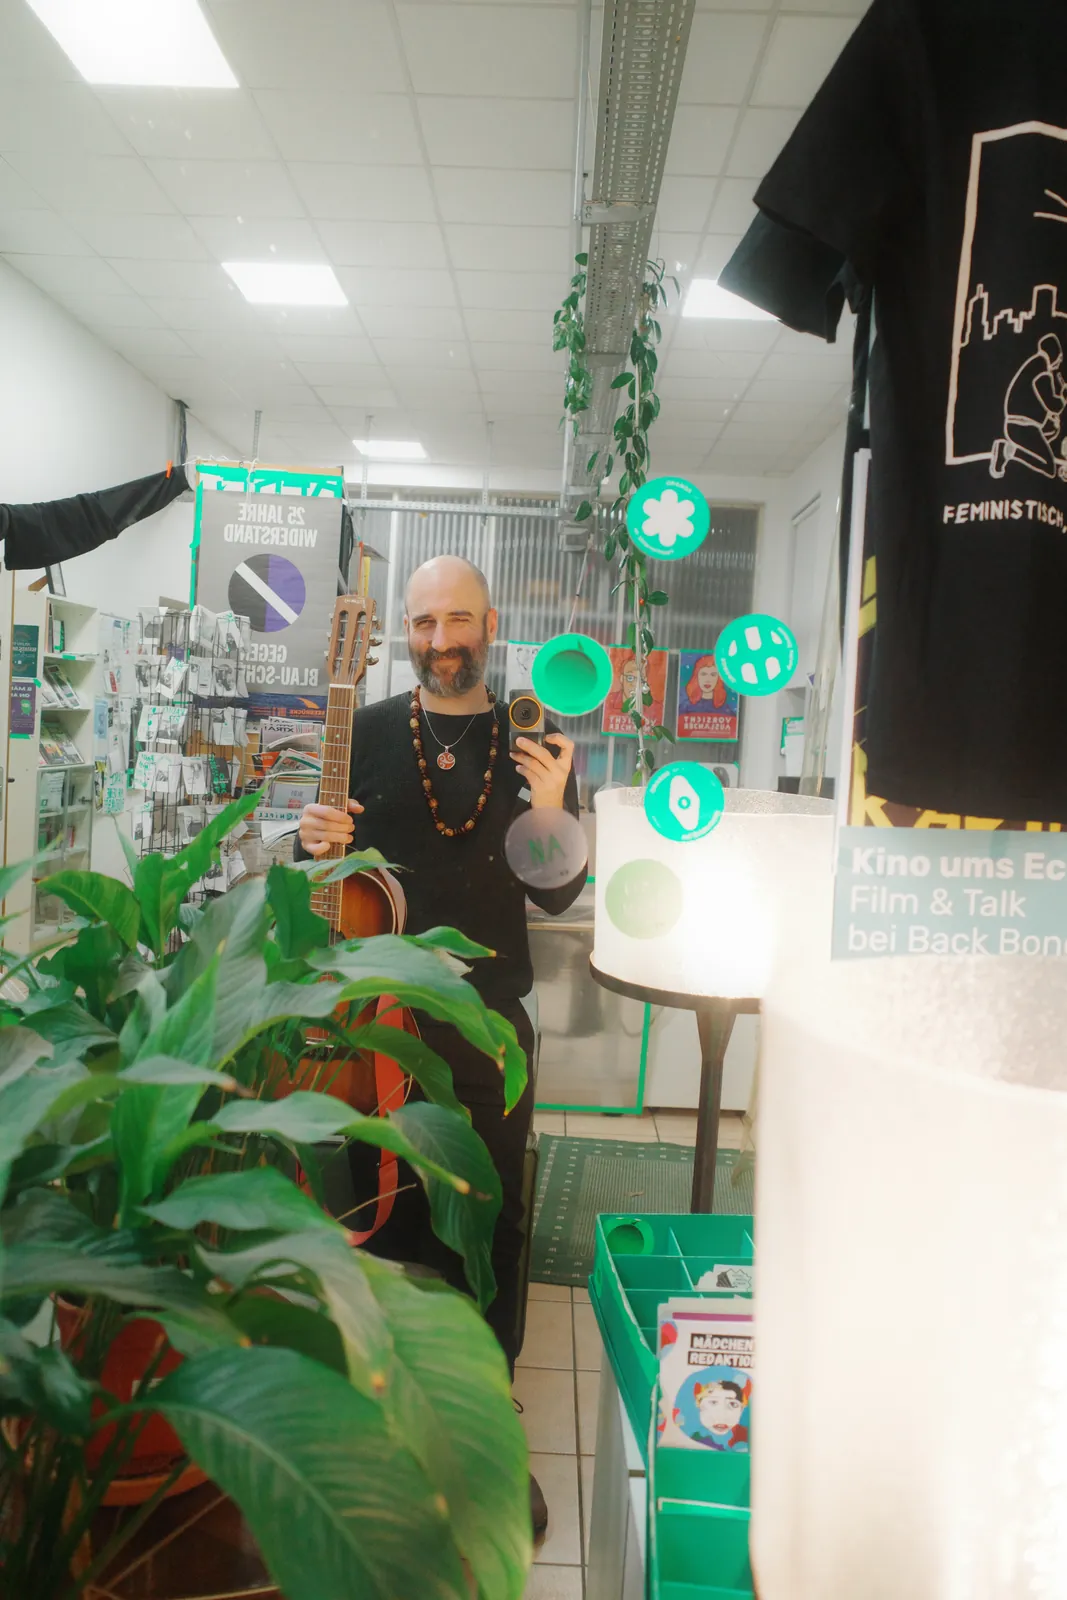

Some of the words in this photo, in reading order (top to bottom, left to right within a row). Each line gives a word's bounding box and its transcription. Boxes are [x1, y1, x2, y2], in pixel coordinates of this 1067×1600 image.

[851, 847, 931, 877] Kino
[940, 856, 1014, 879] ums
[1024, 852, 1066, 880] Ec
[850, 885, 919, 914] Film
[930, 888, 953, 915] &
[963, 889, 1026, 917] Talk
[848, 923, 897, 952] bei
[908, 925, 991, 956] Back
[1001, 928, 1067, 956] Bon
